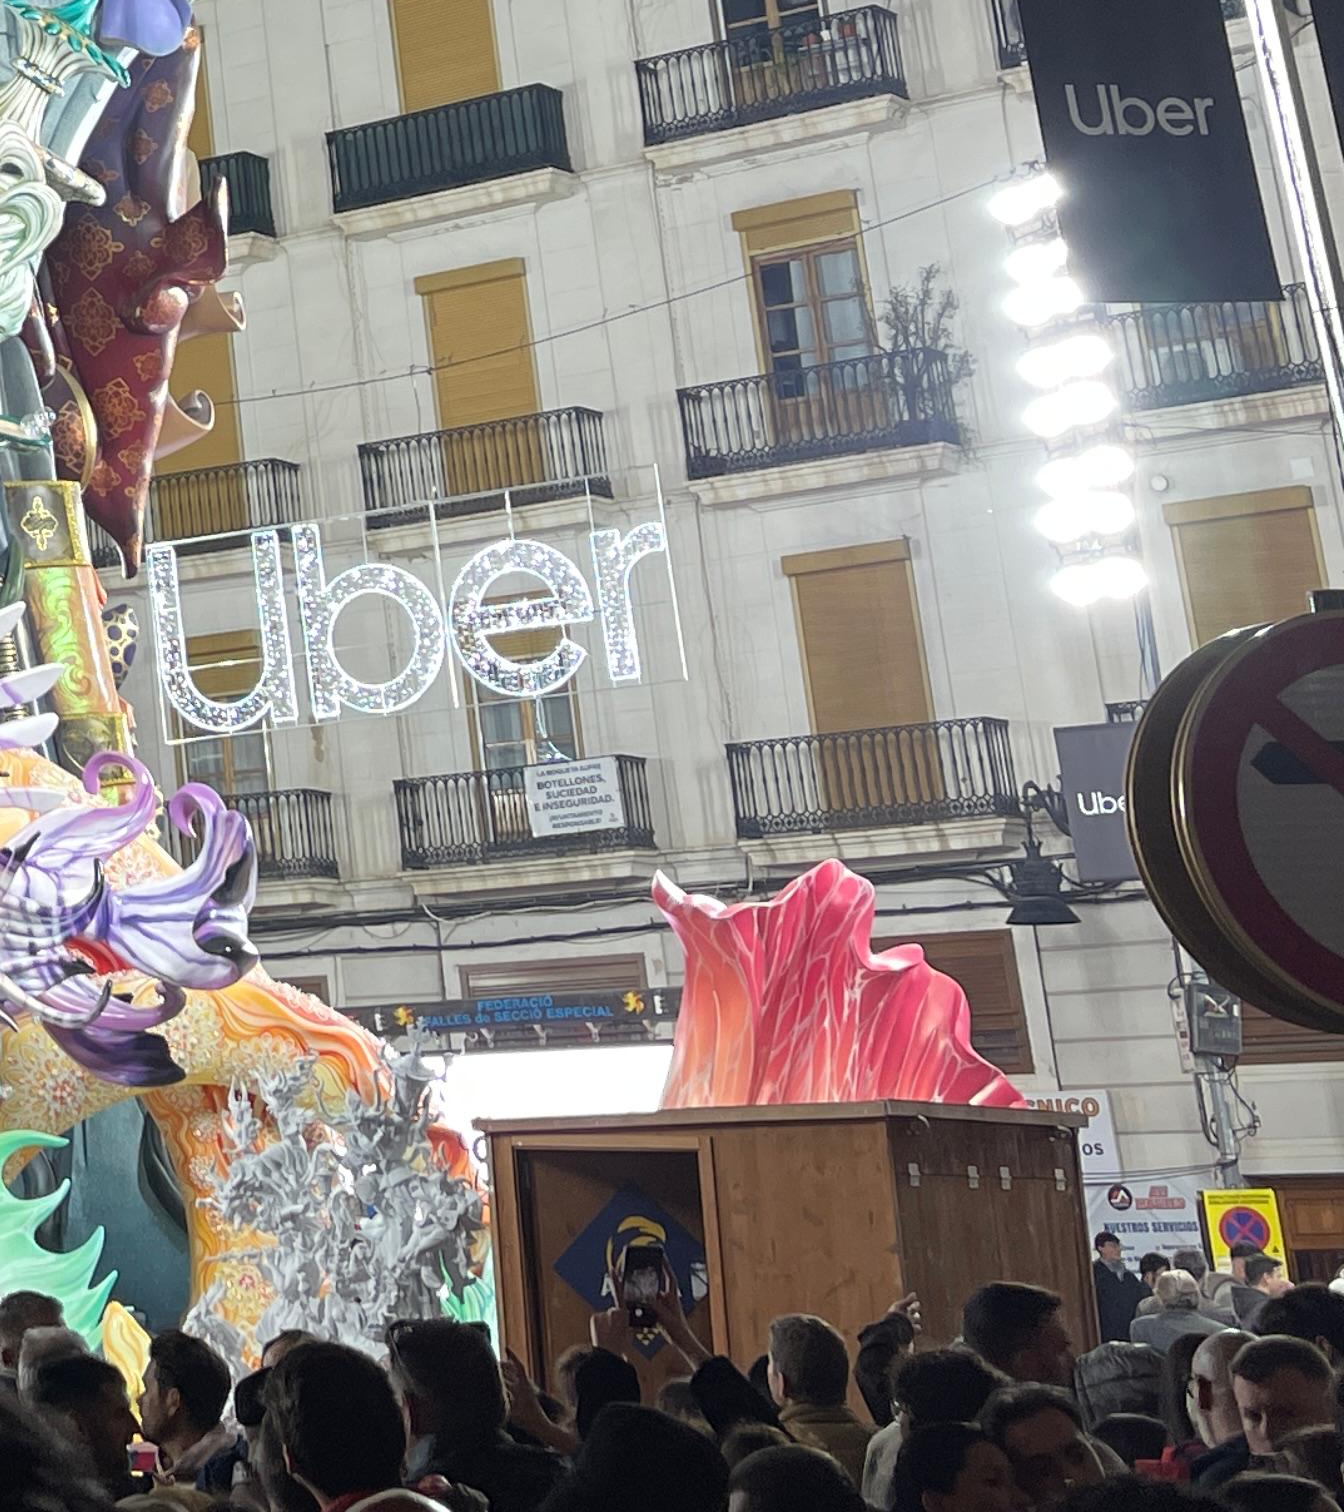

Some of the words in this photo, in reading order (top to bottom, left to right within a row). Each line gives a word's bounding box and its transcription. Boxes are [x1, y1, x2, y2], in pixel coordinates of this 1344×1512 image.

[1065, 84, 1214, 136] Uber
[536, 774, 607, 790] BOTELLONES,
[546, 786, 597, 800] SUCIEDAD
[534, 803, 541, 812] E
[542, 794, 615, 810] INSEGURIDAD.
[477, 993, 553, 1011] FEDERACIÓ
[495, 1007, 542, 1022] SECCIÓ
[546, 1006, 614, 1019] ESPECIAL
[1026, 1096, 1100, 1117] NICO
[1081, 1142, 1104, 1156] OS
[1103, 1222, 1150, 1234] NUESTROS
[1151, 1221, 1199, 1233] SERVICIOS
